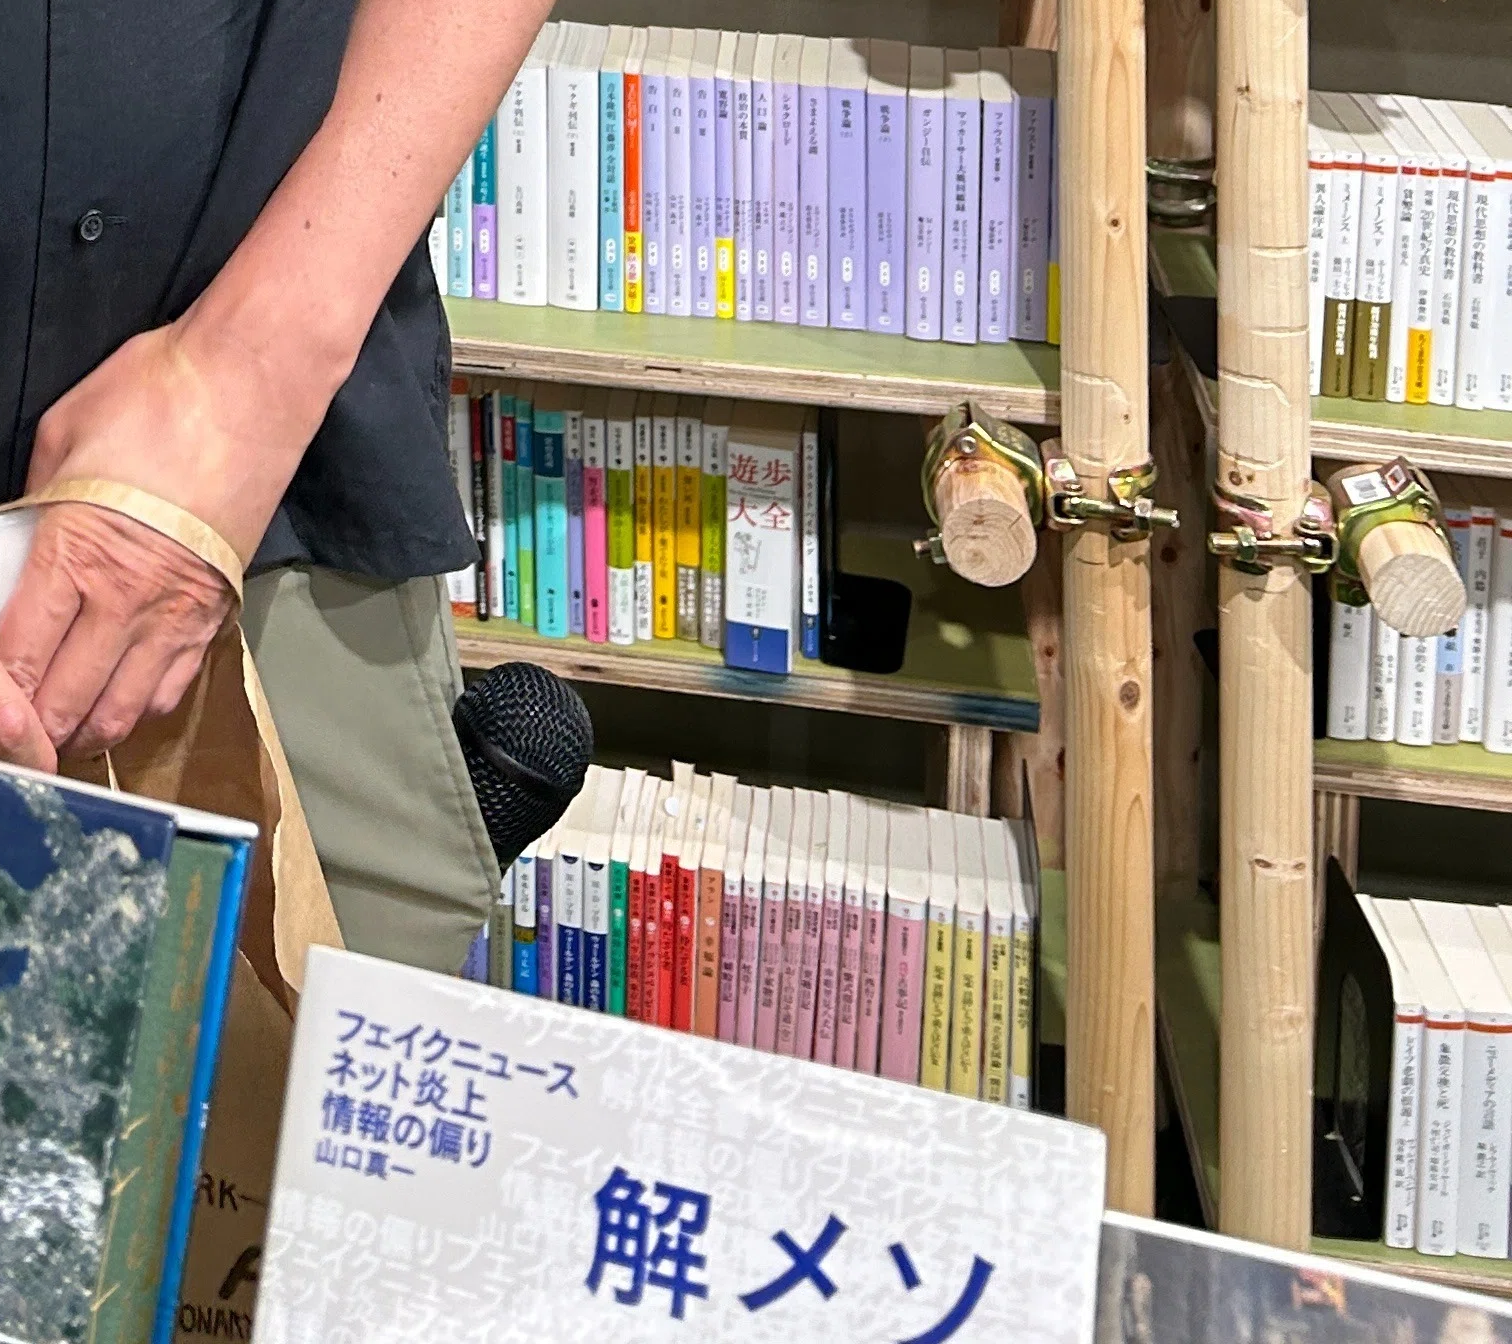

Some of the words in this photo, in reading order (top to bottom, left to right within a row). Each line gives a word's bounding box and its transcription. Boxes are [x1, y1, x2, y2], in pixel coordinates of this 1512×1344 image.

[513, 80, 524, 130] マタギ列伝
[567, 82, 579, 130] マタギ列伝
[728, 452, 792, 487] 遊歩
[731, 496, 792, 532] 大全
[325, 1051, 488, 1121] ネット炎上
[333, 1009, 580, 1101] フェイクニュース
[313, 1140, 416, 1180] 山口真一
[321, 1088, 493, 1168] 情報の偏り
[584, 1164, 713, 1321] 解
[739, 1212, 851, 1314] メ
[886, 1240, 998, 1344] ソ
